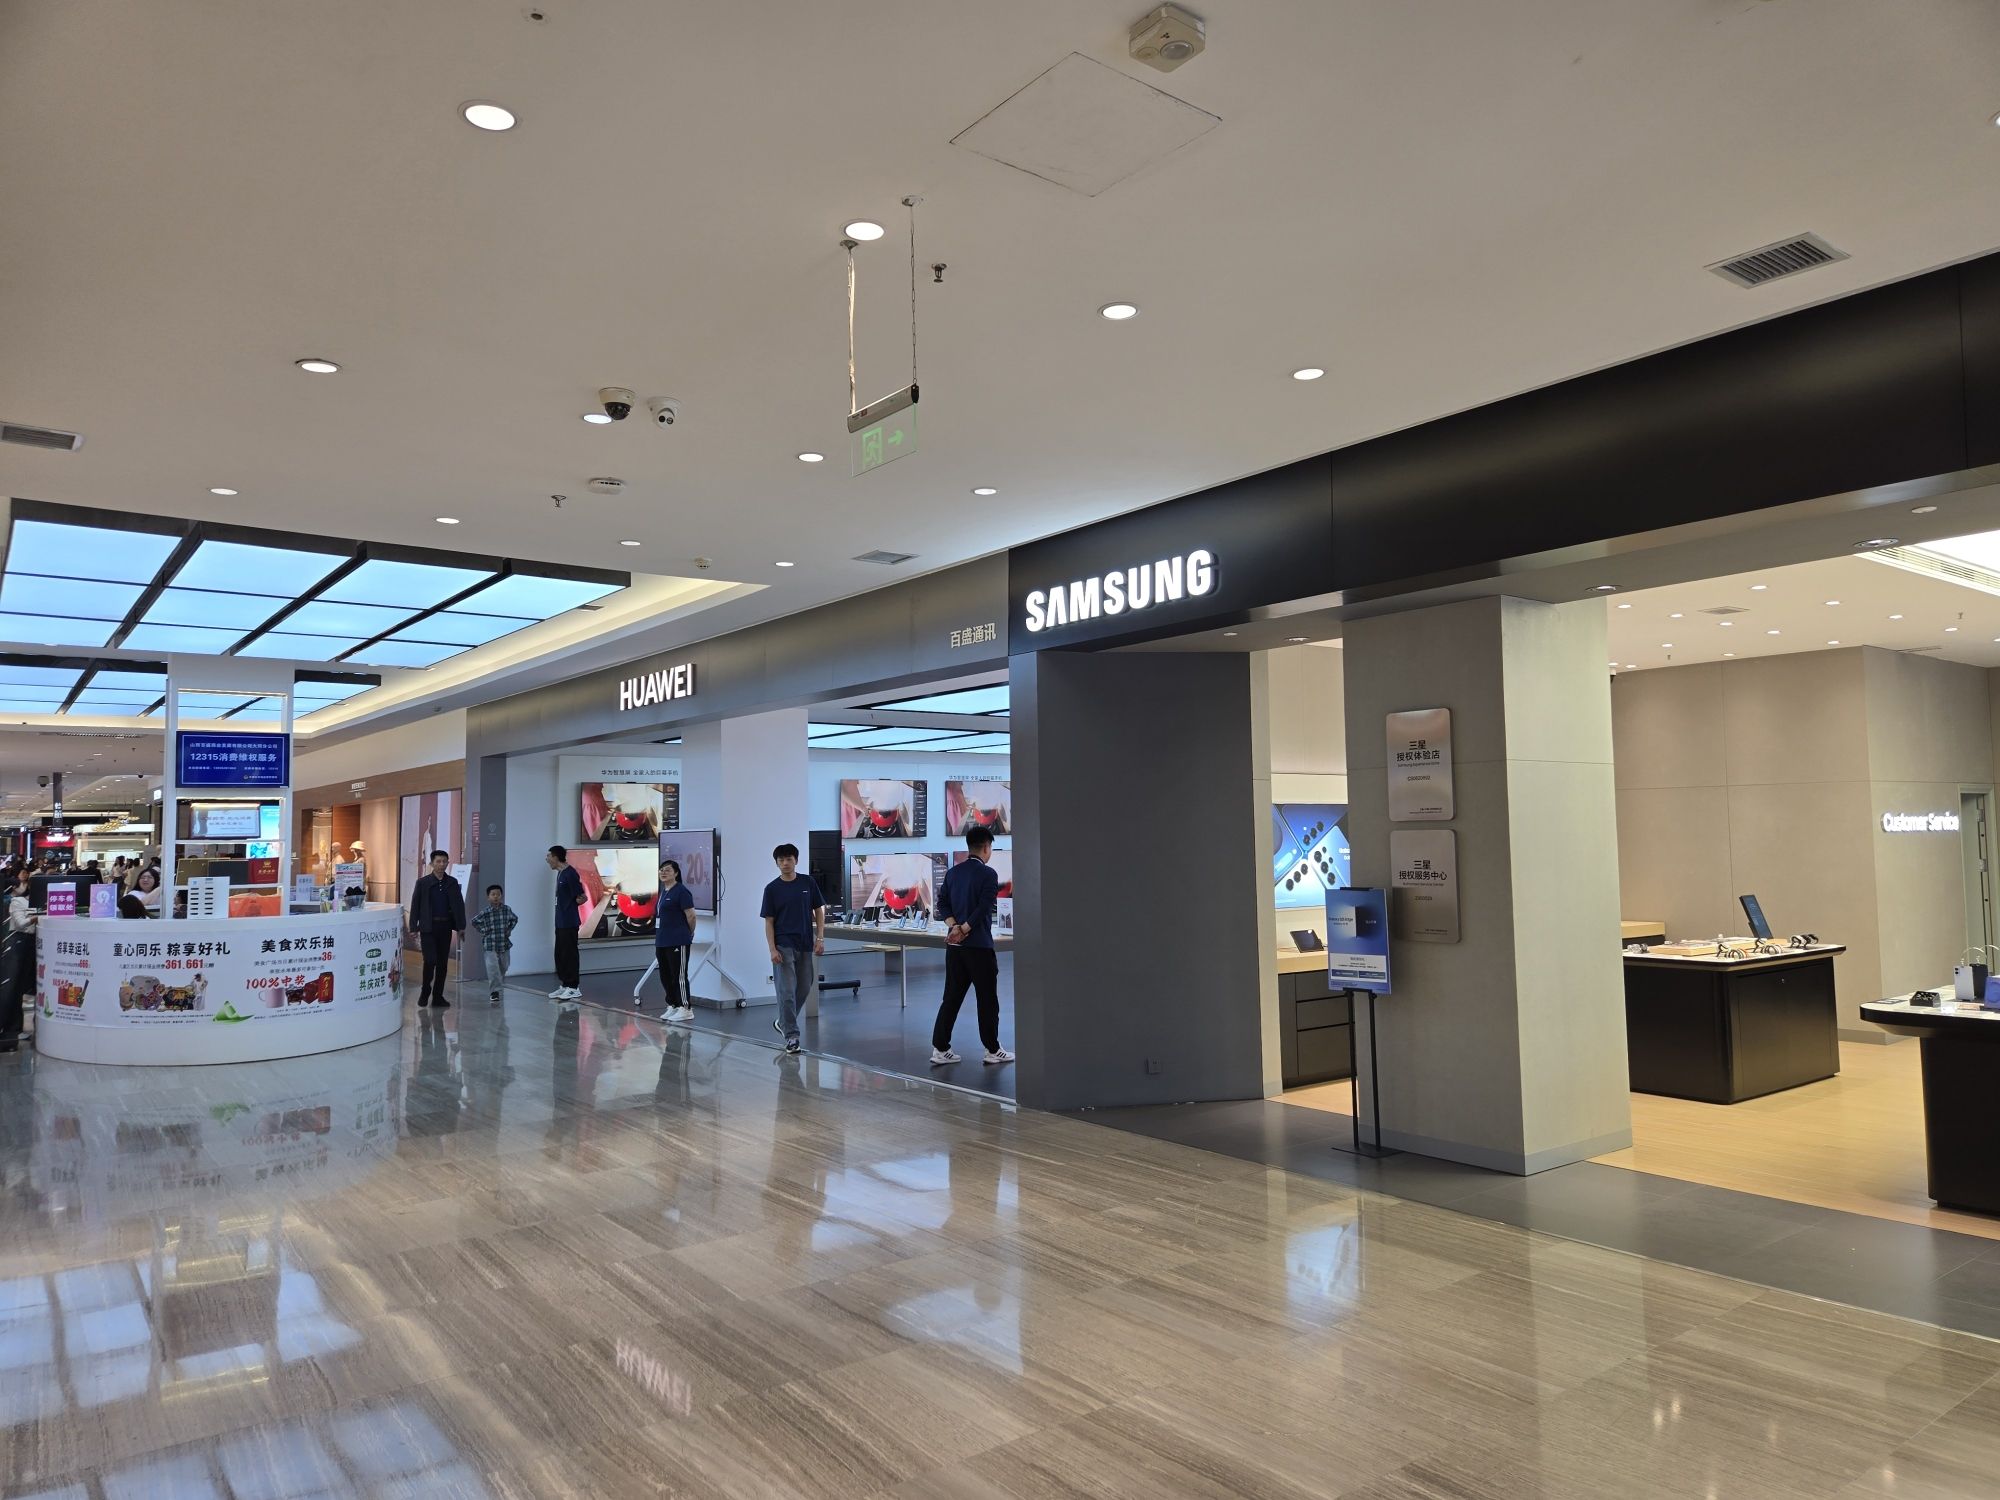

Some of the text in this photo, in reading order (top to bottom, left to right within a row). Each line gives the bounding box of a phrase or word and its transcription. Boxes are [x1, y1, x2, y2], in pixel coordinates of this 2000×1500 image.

[1025, 549, 1212, 632] SAMSUNG
[950, 622, 997, 648] 百盛通讯
[620, 663, 692, 711] HUAWEI
[1408, 740, 1426, 750] 三星
[190, 753, 277, 762] 12315消费维权服务
[1396, 750, 1441, 762] 授权体验店
[1413, 860, 1431, 870] 三星
[1399, 870, 1448, 881] 授权服务中心
[261, 936, 335, 953] 美食欢乐抽
[359, 930, 391, 945] PARKSON
[113, 941, 231, 957] 童心同乐 粽享好礼
[246, 974, 306, 990] 100%中奖
